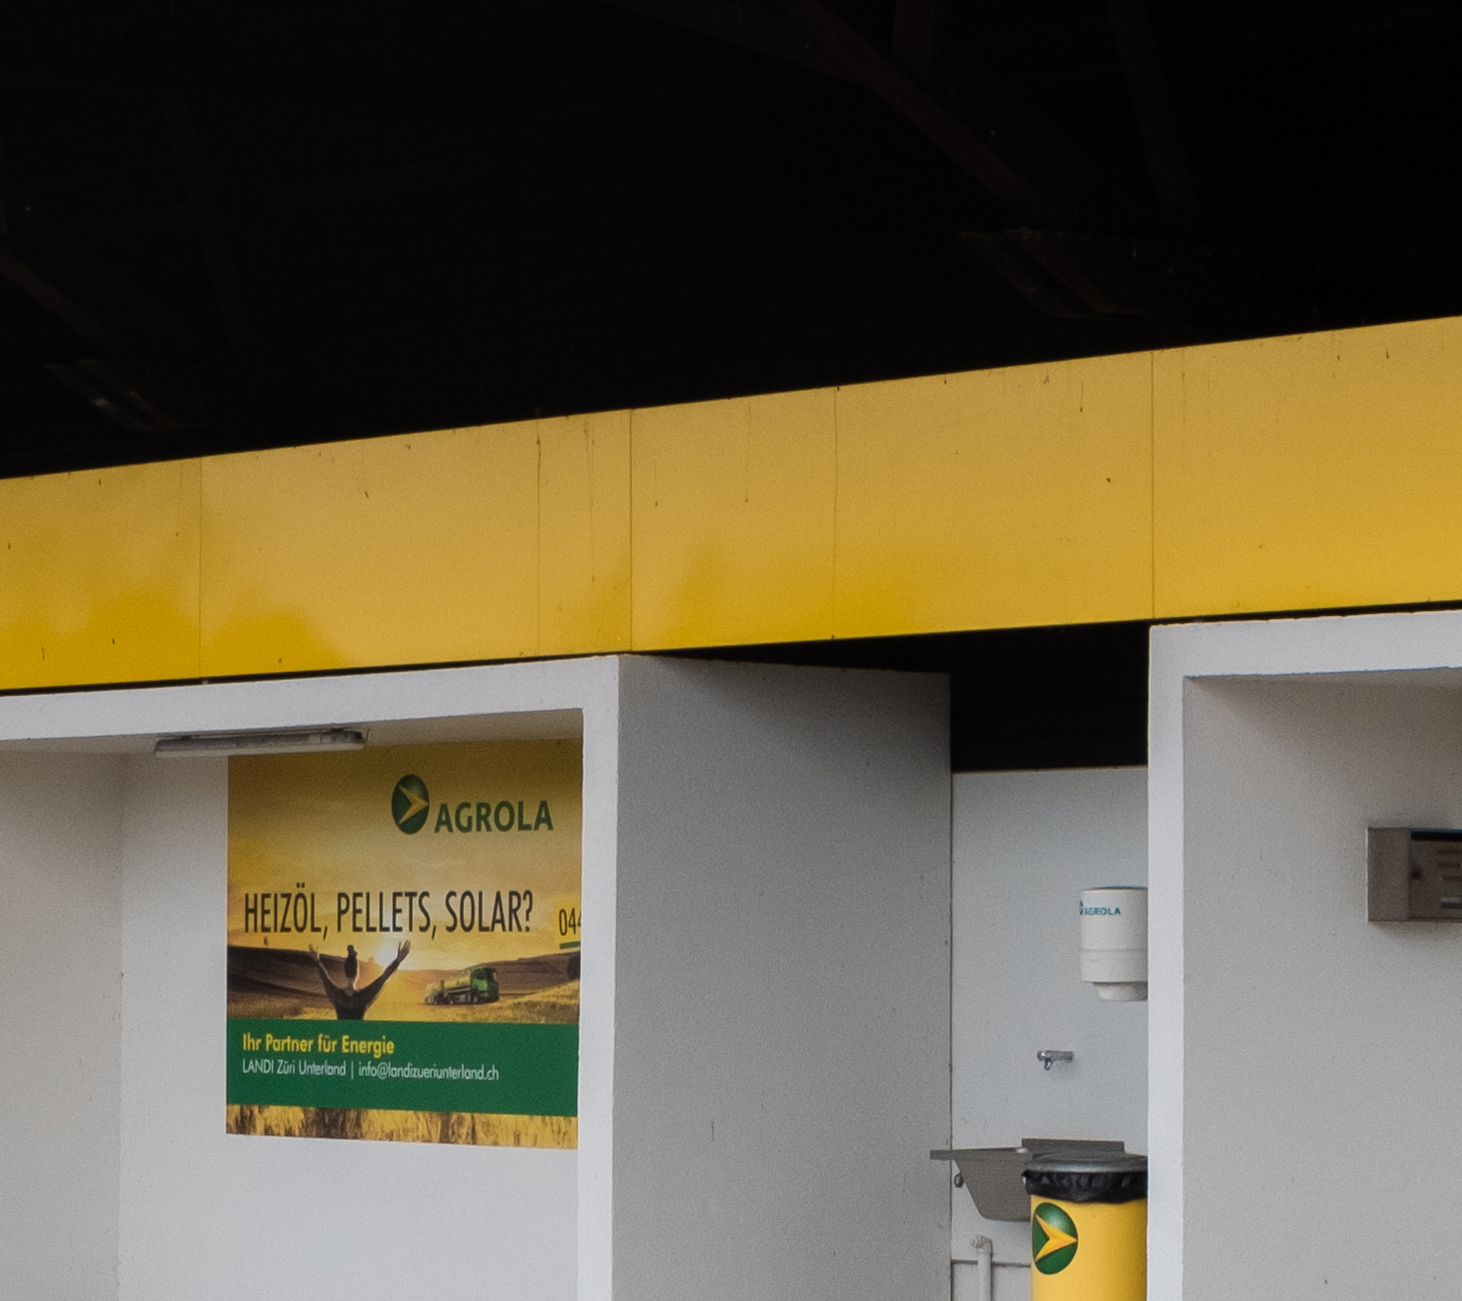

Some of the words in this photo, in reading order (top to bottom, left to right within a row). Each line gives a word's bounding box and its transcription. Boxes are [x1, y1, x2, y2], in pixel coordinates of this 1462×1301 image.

[434, 800, 554, 833] AGROLA
[244, 882, 328, 941] HEIZÖL,
[336, 890, 437, 941] PELLETS,
[445, 889, 534, 933] SOLAR?
[243, 1032, 262, 1051] Ihr
[265, 1033, 314, 1052] Partner
[317, 1033, 337, 1053] für
[341, 1035, 394, 1058] Energie
[242, 1058, 274, 1074] LANDI
[299, 1060, 347, 1076] Unterland
